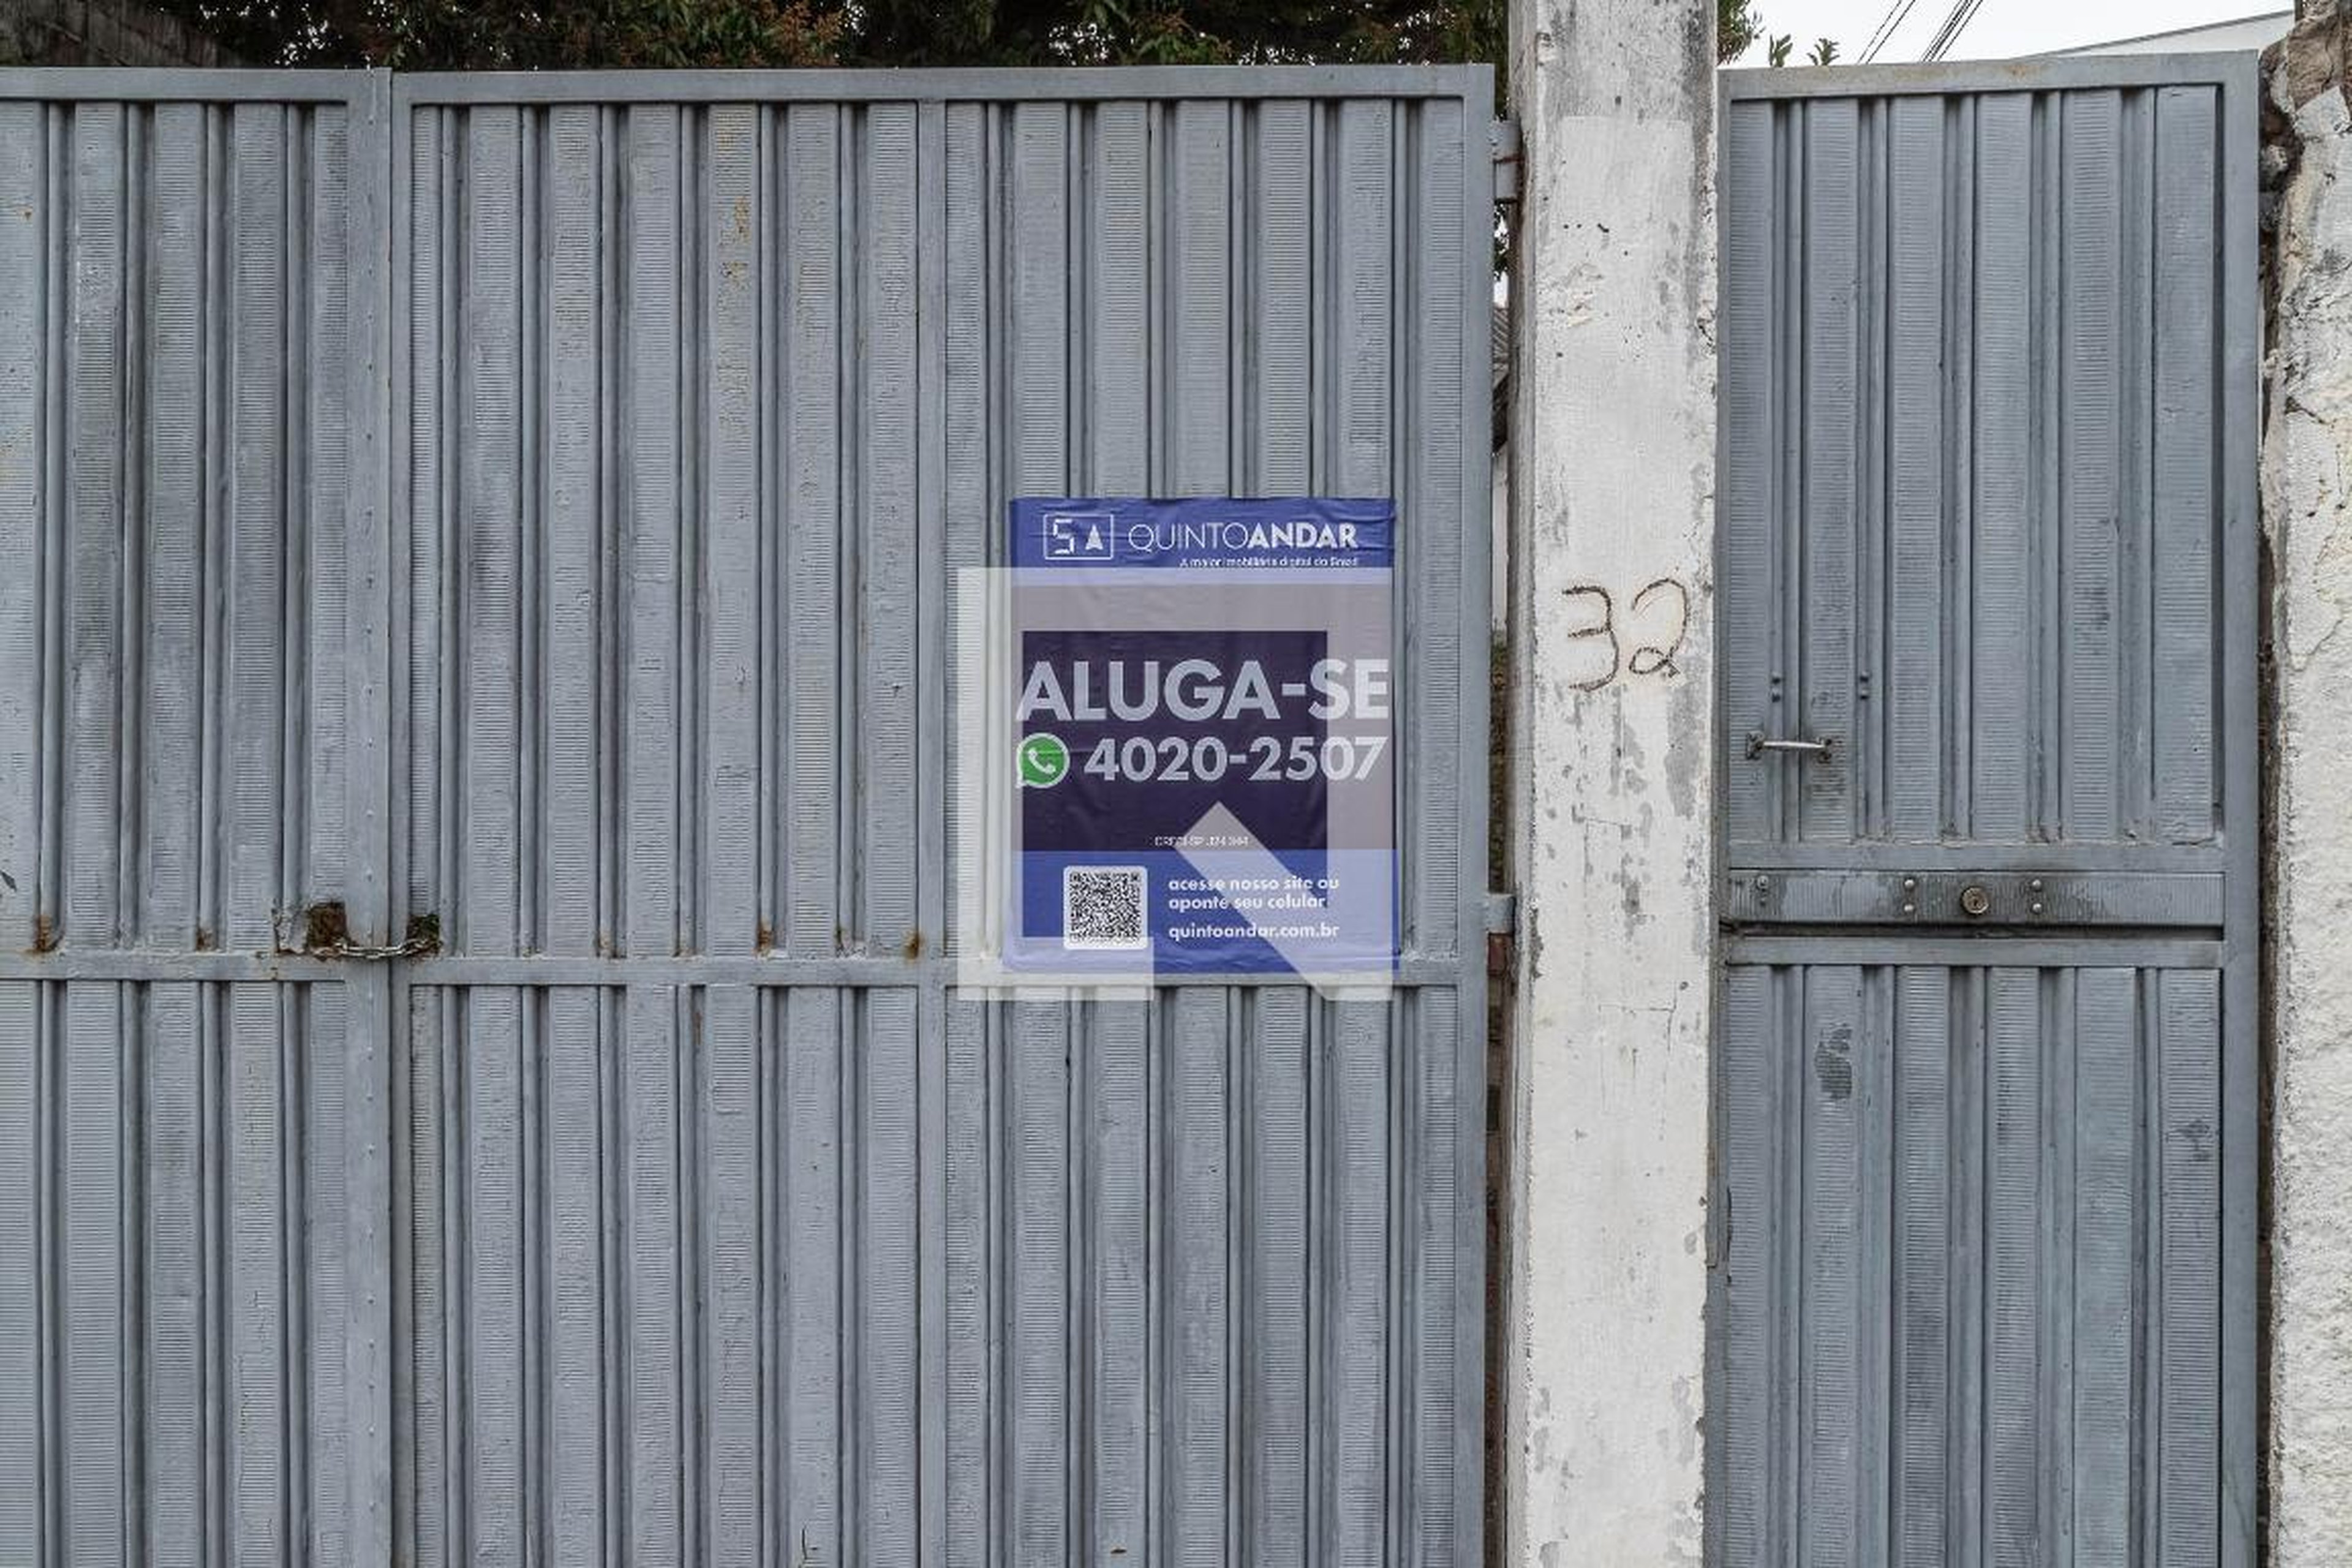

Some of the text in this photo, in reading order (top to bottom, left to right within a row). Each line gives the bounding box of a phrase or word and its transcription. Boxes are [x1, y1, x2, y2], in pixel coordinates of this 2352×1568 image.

[1128, 522, 1359, 552] QUINTOANDAR
[1562, 578, 1689, 692] 32
[1015, 658, 1389, 722] ALUGA-SE
[1084, 736, 1389, 782] 4020-2507
[1169, 875, 1340, 891] acesse nosso site ou
[1169, 893, 1326, 913] aponte seu celular
[1169, 922, 1340, 942] quintoandar.com.br
